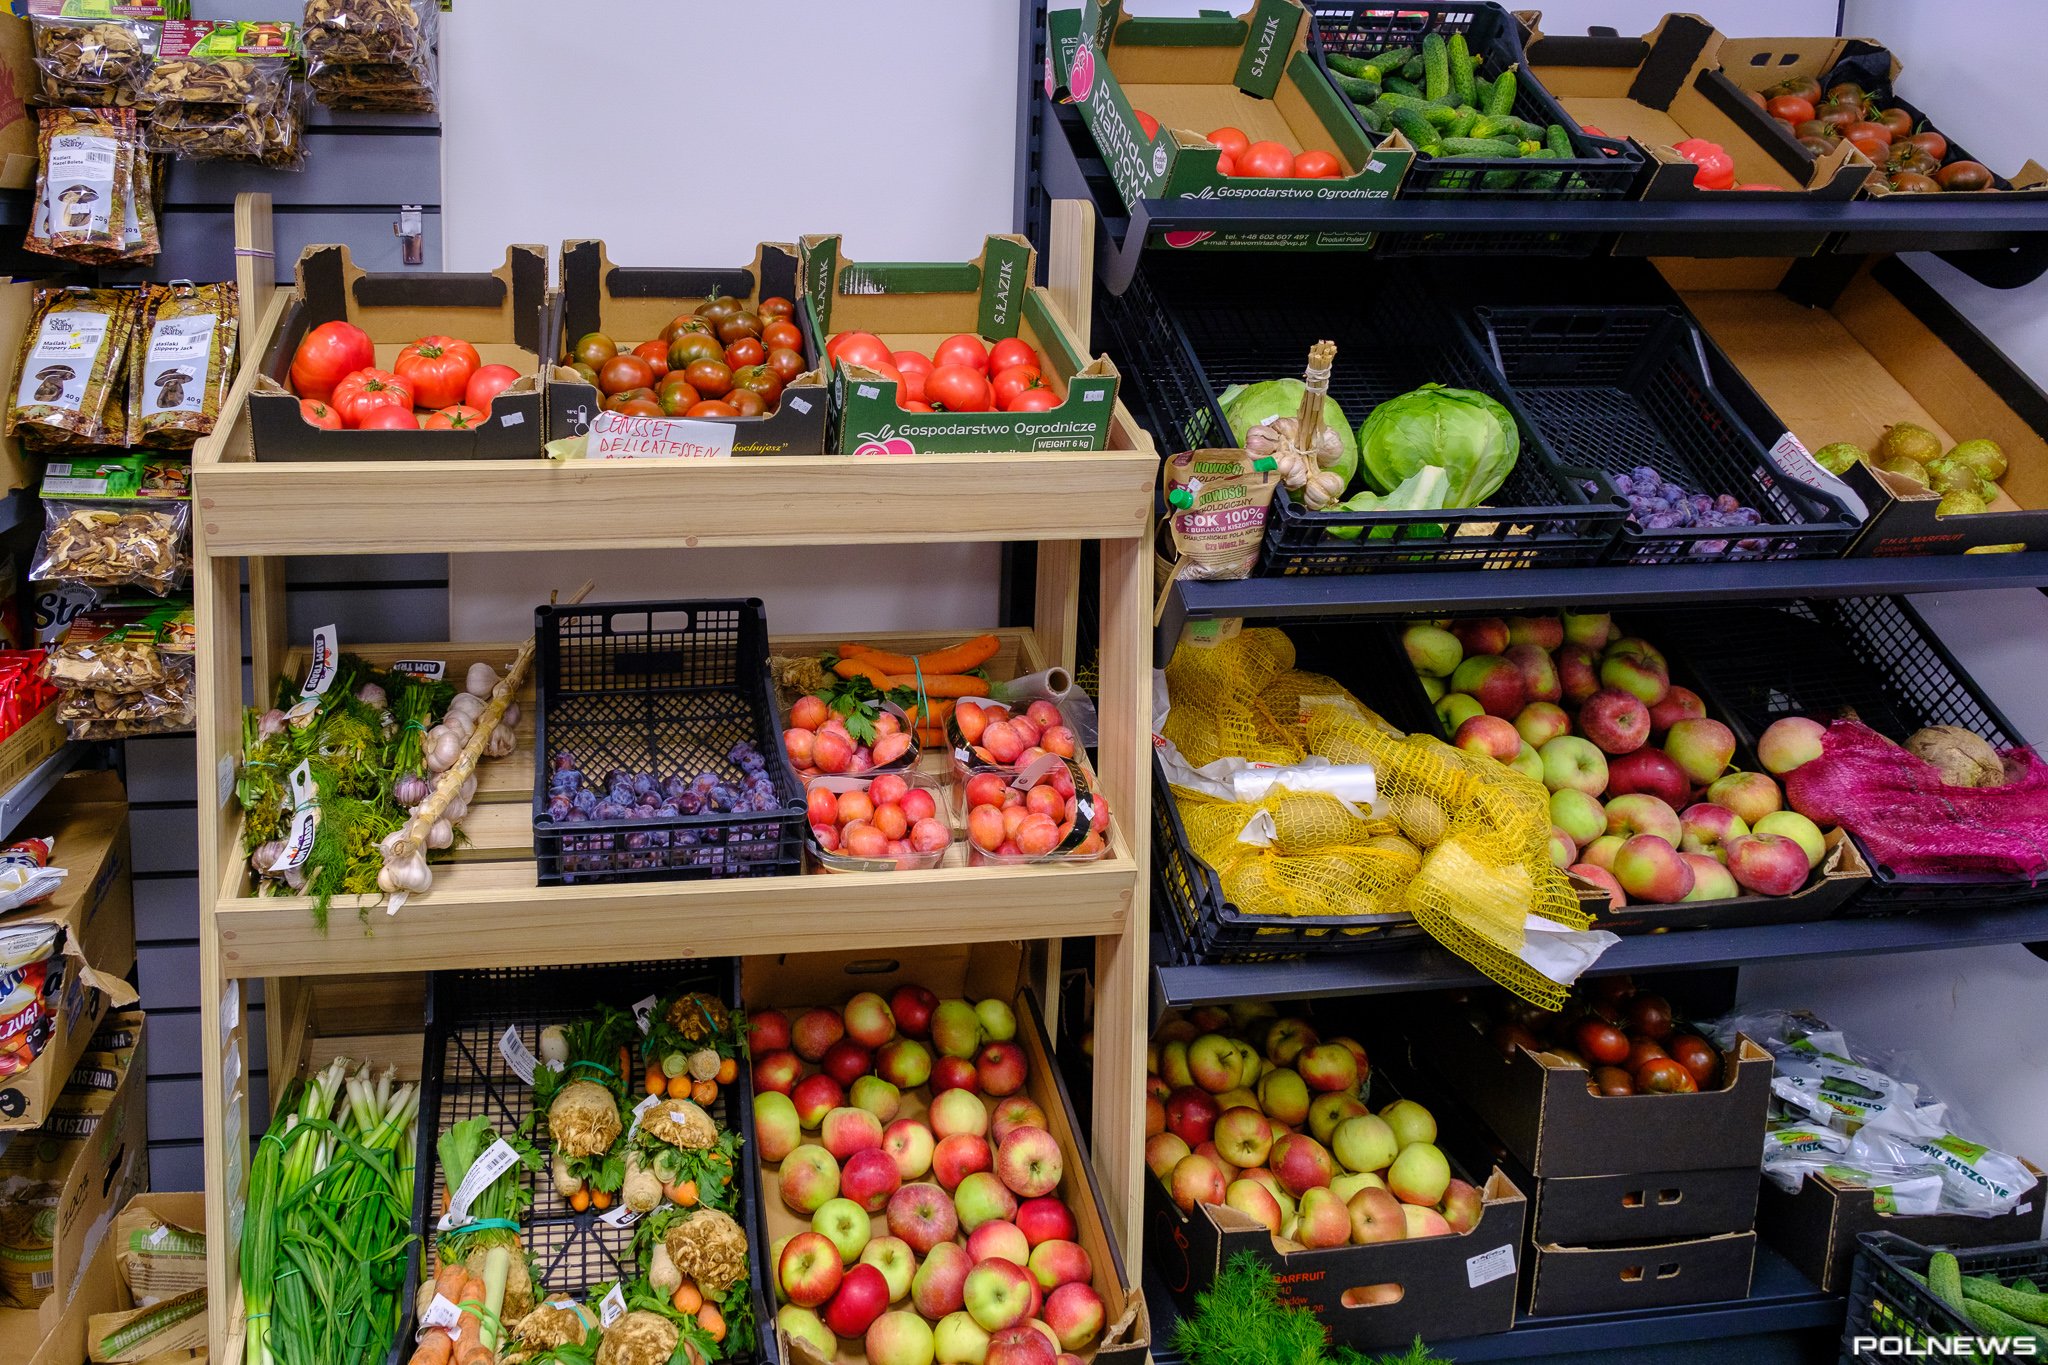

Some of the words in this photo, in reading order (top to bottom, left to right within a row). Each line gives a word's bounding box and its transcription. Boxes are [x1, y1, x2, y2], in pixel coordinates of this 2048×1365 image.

[1251, 16, 1281, 78] S.ŁAZIK
[1100, 79, 1153, 186] Pomidor
[1113, 161, 1137, 216] S.ŁAZ
[1217, 187, 1314, 199] Gospodarstwo
[1317, 188, 1389, 199] Ogrodnicze
[817, 257, 829, 323] S.ŁAZIK
[993, 259, 1014, 325] S.ŁAZIK
[898, 424, 1010, 437] Gospodarstwo
[1014, 422, 1097, 435] Ogrodnicze
[600, 437, 721, 458] DELICATESSEN
[1038, 440, 1071, 449] WEIGHT
[1079, 440, 1089, 449] kg
[1197, 498, 1254, 514] KOLOGICZNY
[1199, 485, 1248, 507] NOWOŚĆ!
[1184, 514, 1219, 527] SOK
[1225, 507, 1264, 524] 100%
[1227, 520, 1263, 531] KISZONYCH
[1910, 533, 1965, 543] MARFRUIT
[316, 639, 325, 662] ADM
[307, 663, 323, 689] TRADE
[414, 662, 436, 672] ADM
[56, 1116, 99, 1135] KISZON
[1945, 1156, 2010, 1199] KISZONE
[1313, 1304, 1324, 1312] 28
